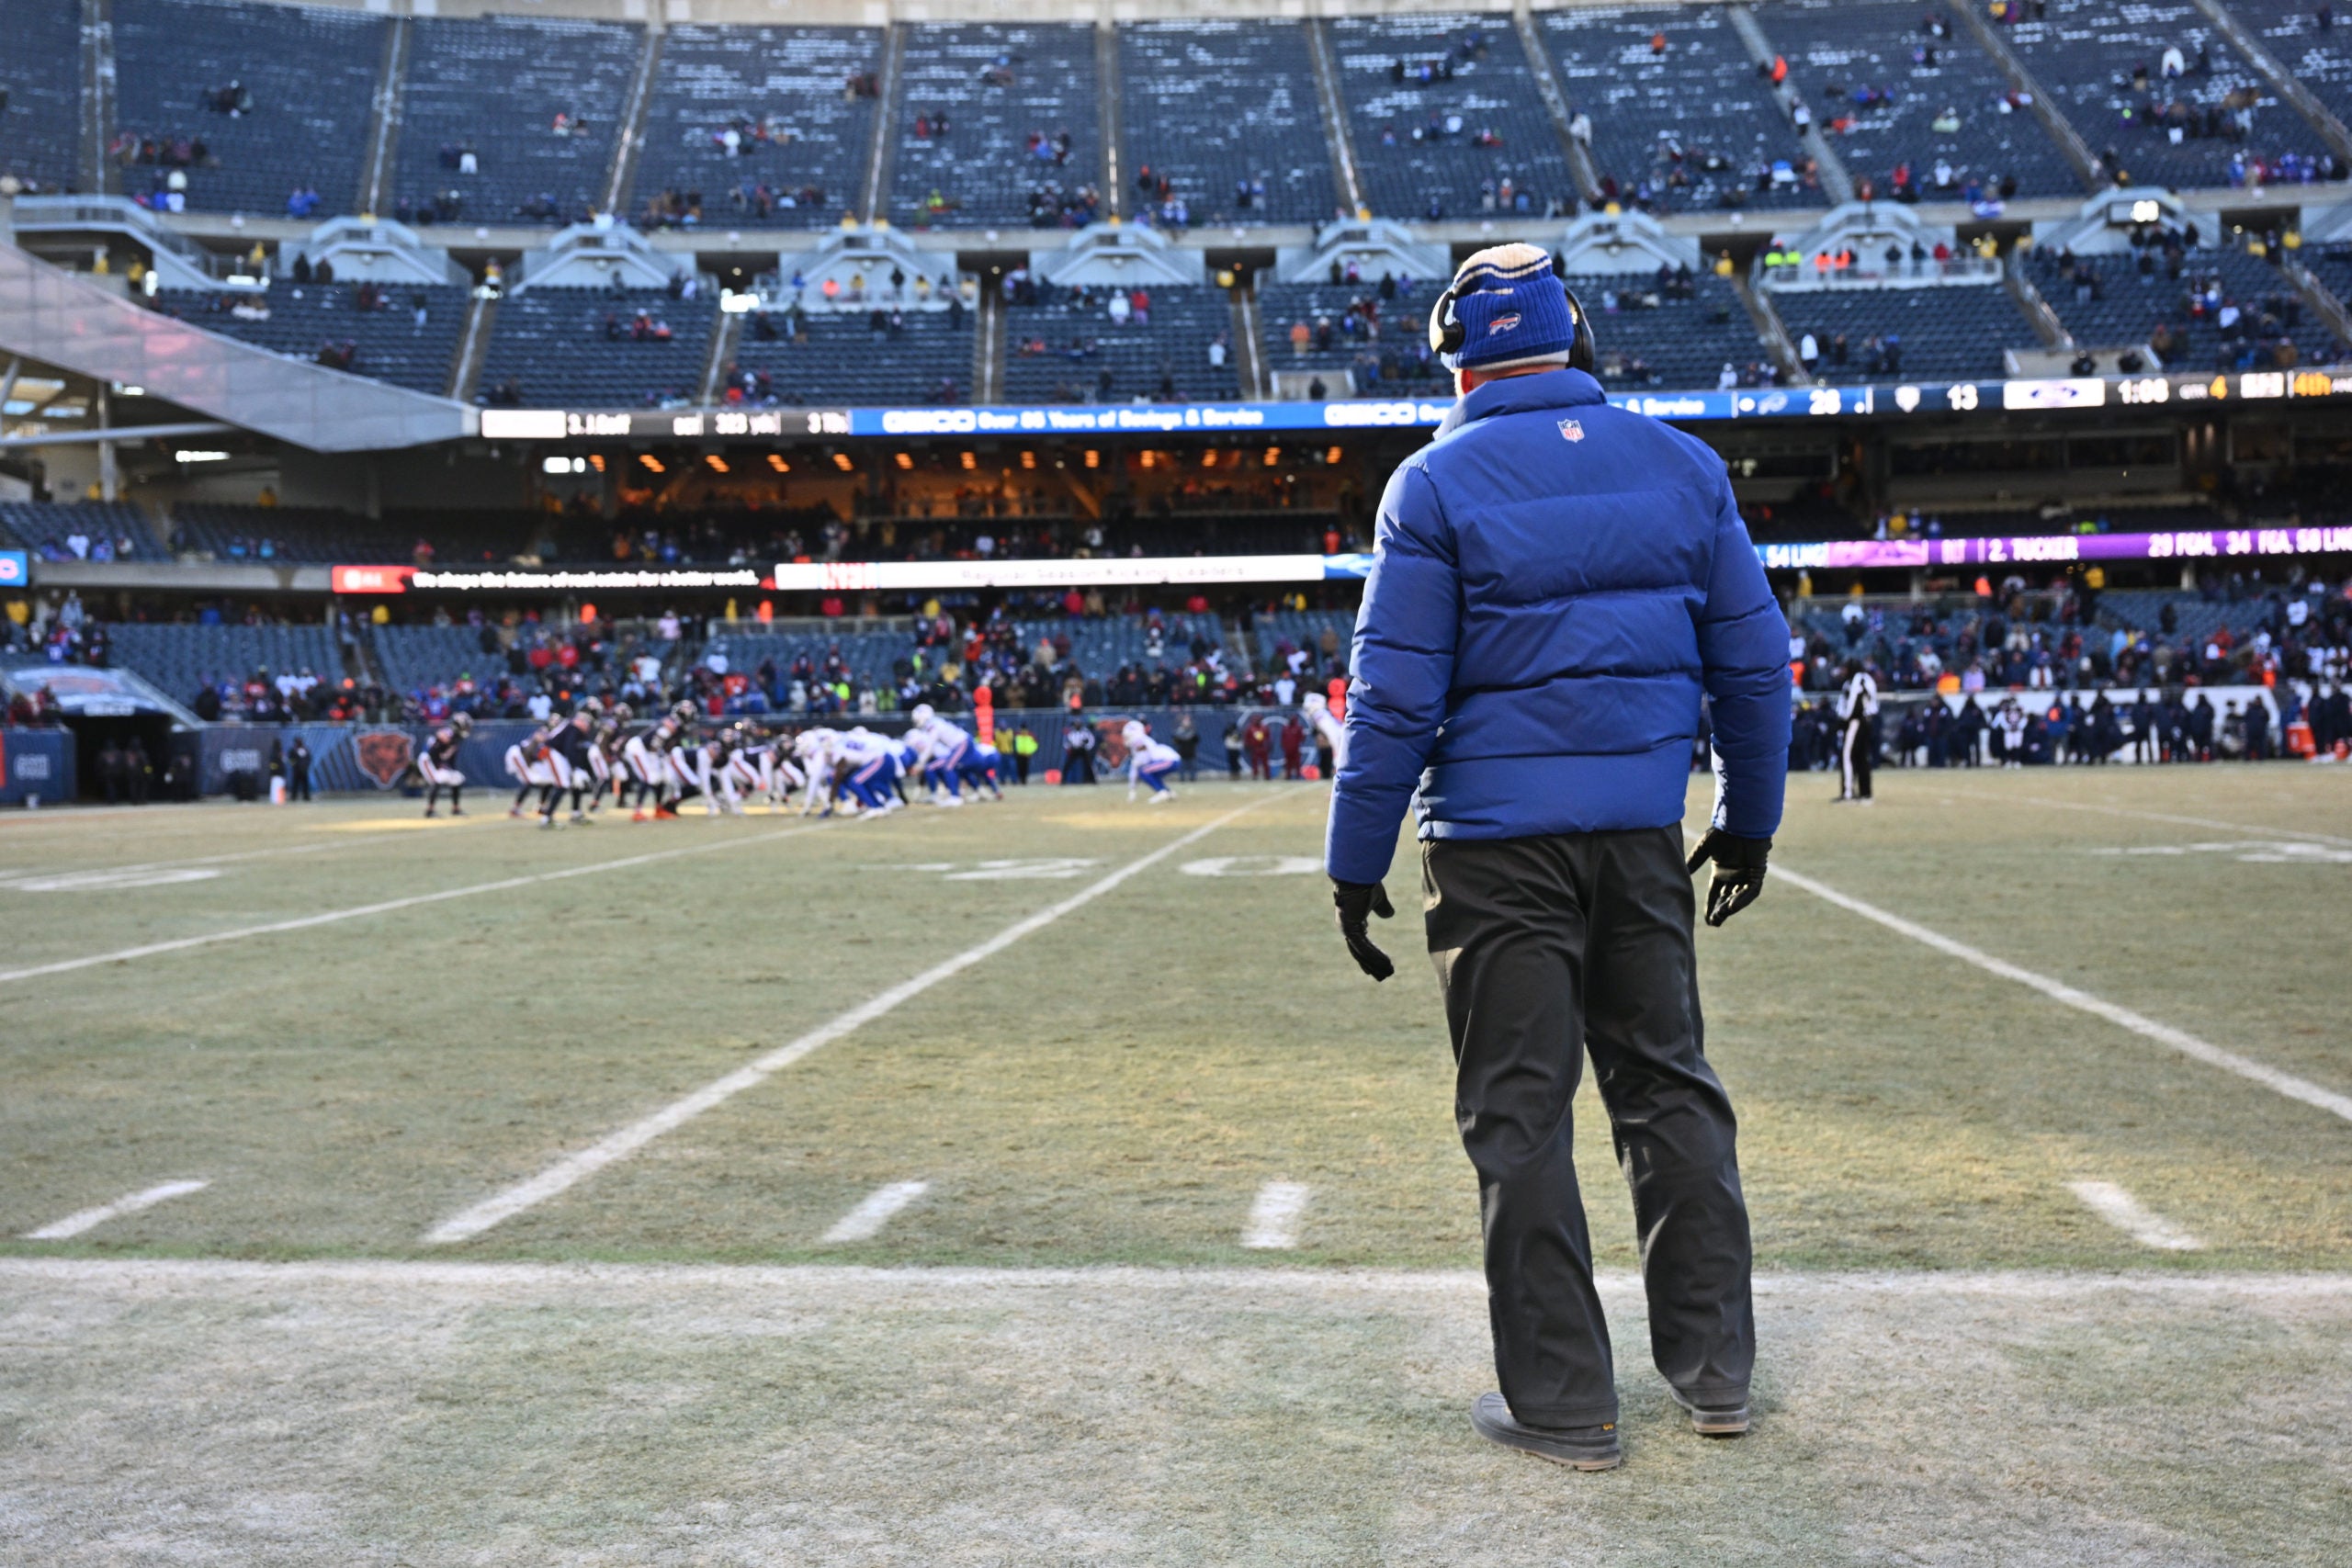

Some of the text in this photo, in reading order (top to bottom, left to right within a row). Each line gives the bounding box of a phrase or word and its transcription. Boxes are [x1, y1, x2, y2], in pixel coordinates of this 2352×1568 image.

[1947, 384, 1979, 411] 13
[2210, 375, 2228, 400] 4
[1202, 408, 1264, 426] Service
[1643, 397, 1705, 416] Service
[1564, 427, 1582, 439] NFL
[2011, 537, 2078, 561] TUCKER
